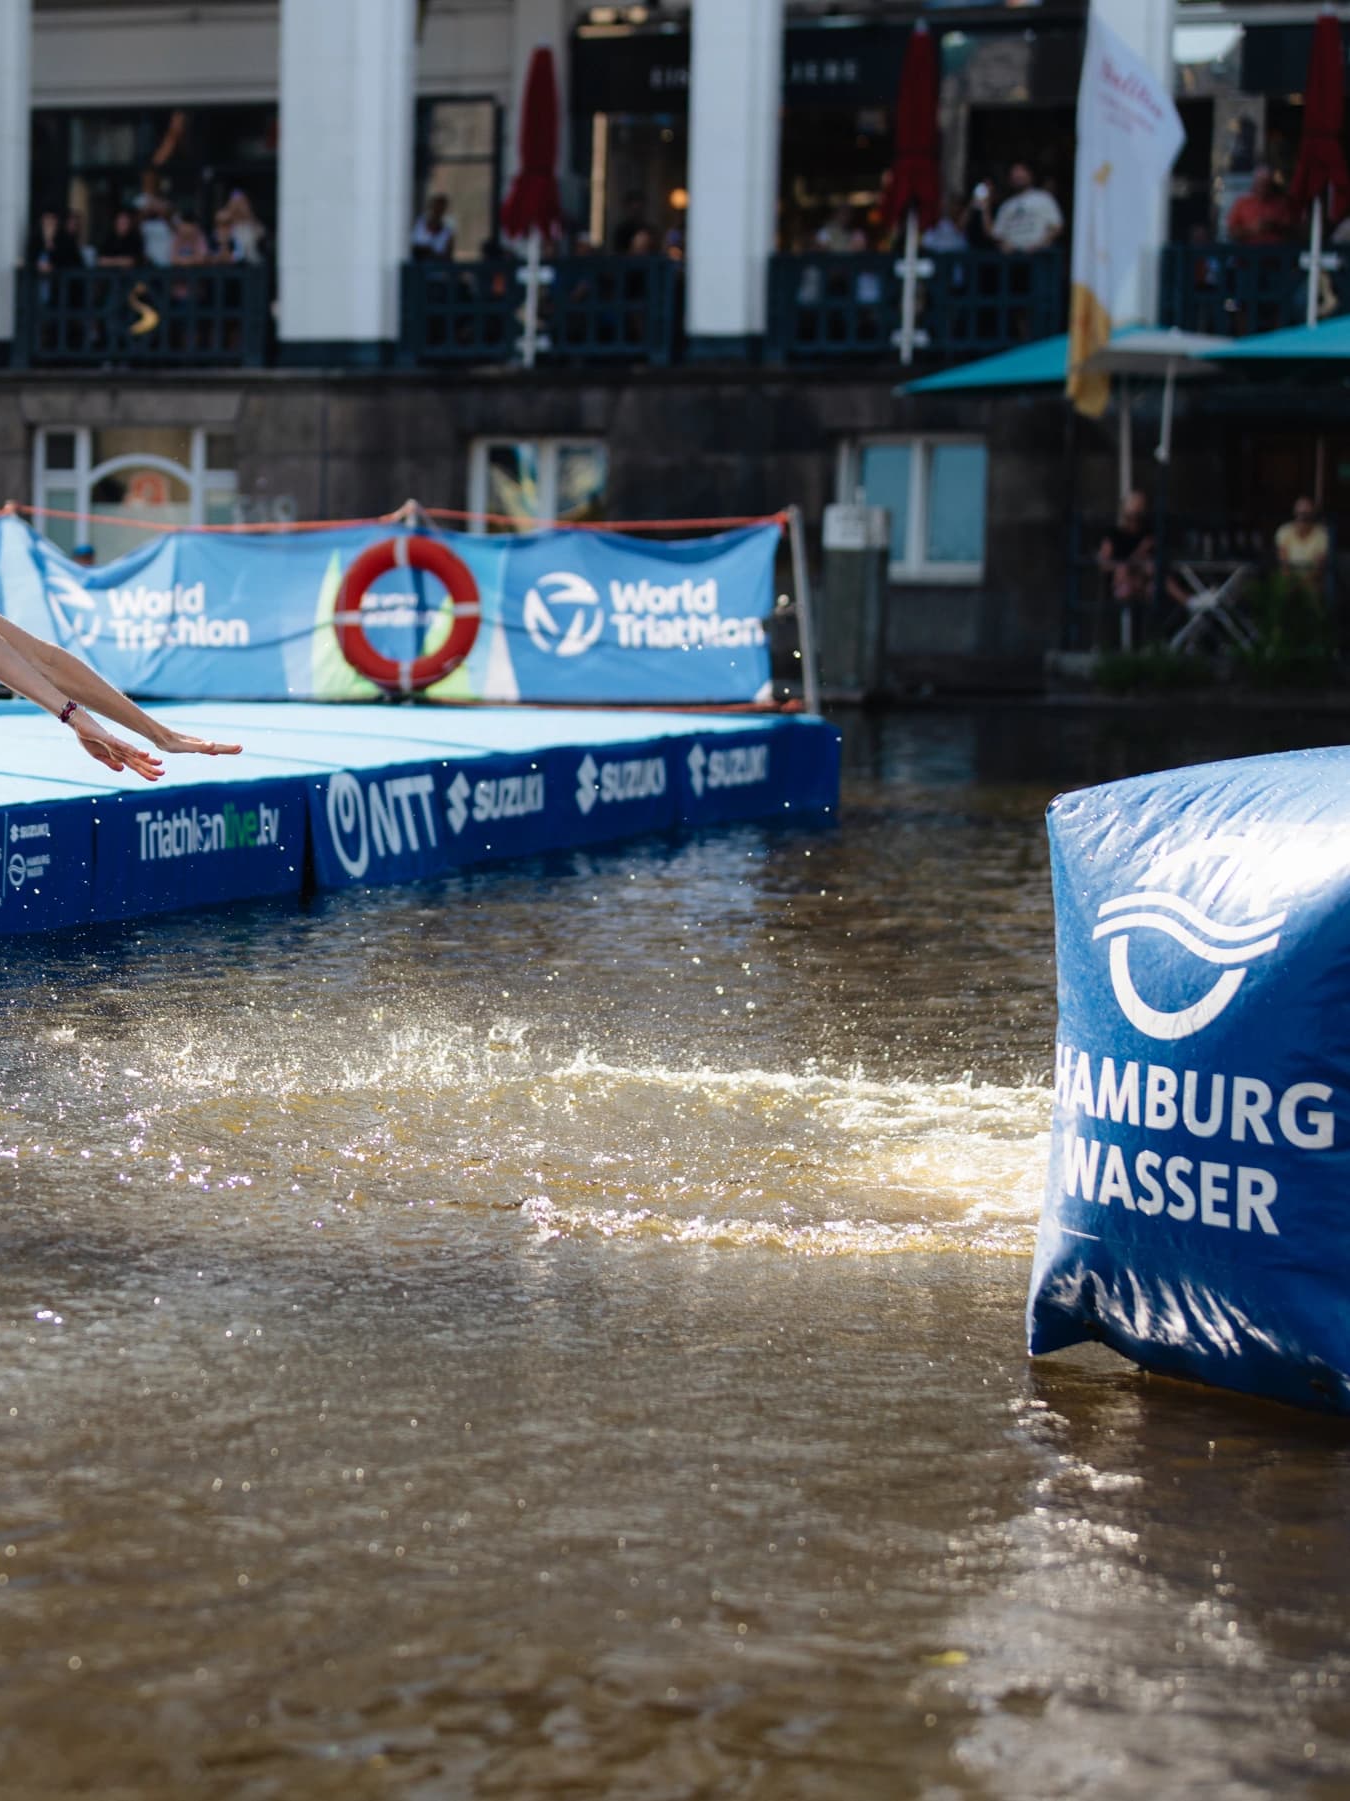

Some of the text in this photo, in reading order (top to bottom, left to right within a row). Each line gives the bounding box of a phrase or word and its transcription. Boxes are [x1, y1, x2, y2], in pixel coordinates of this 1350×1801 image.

[107, 580, 205, 618] World
[609, 578, 718, 614] World
[109, 614, 249, 651] Triathlon
[610, 613, 766, 648] Triathlon
[368, 774, 437, 857] NTT
[472, 773, 544, 822] SUZUKI
[1055, 1042, 1336, 1151] HAMBURG
[1063, 1128, 1281, 1237] WASSER
